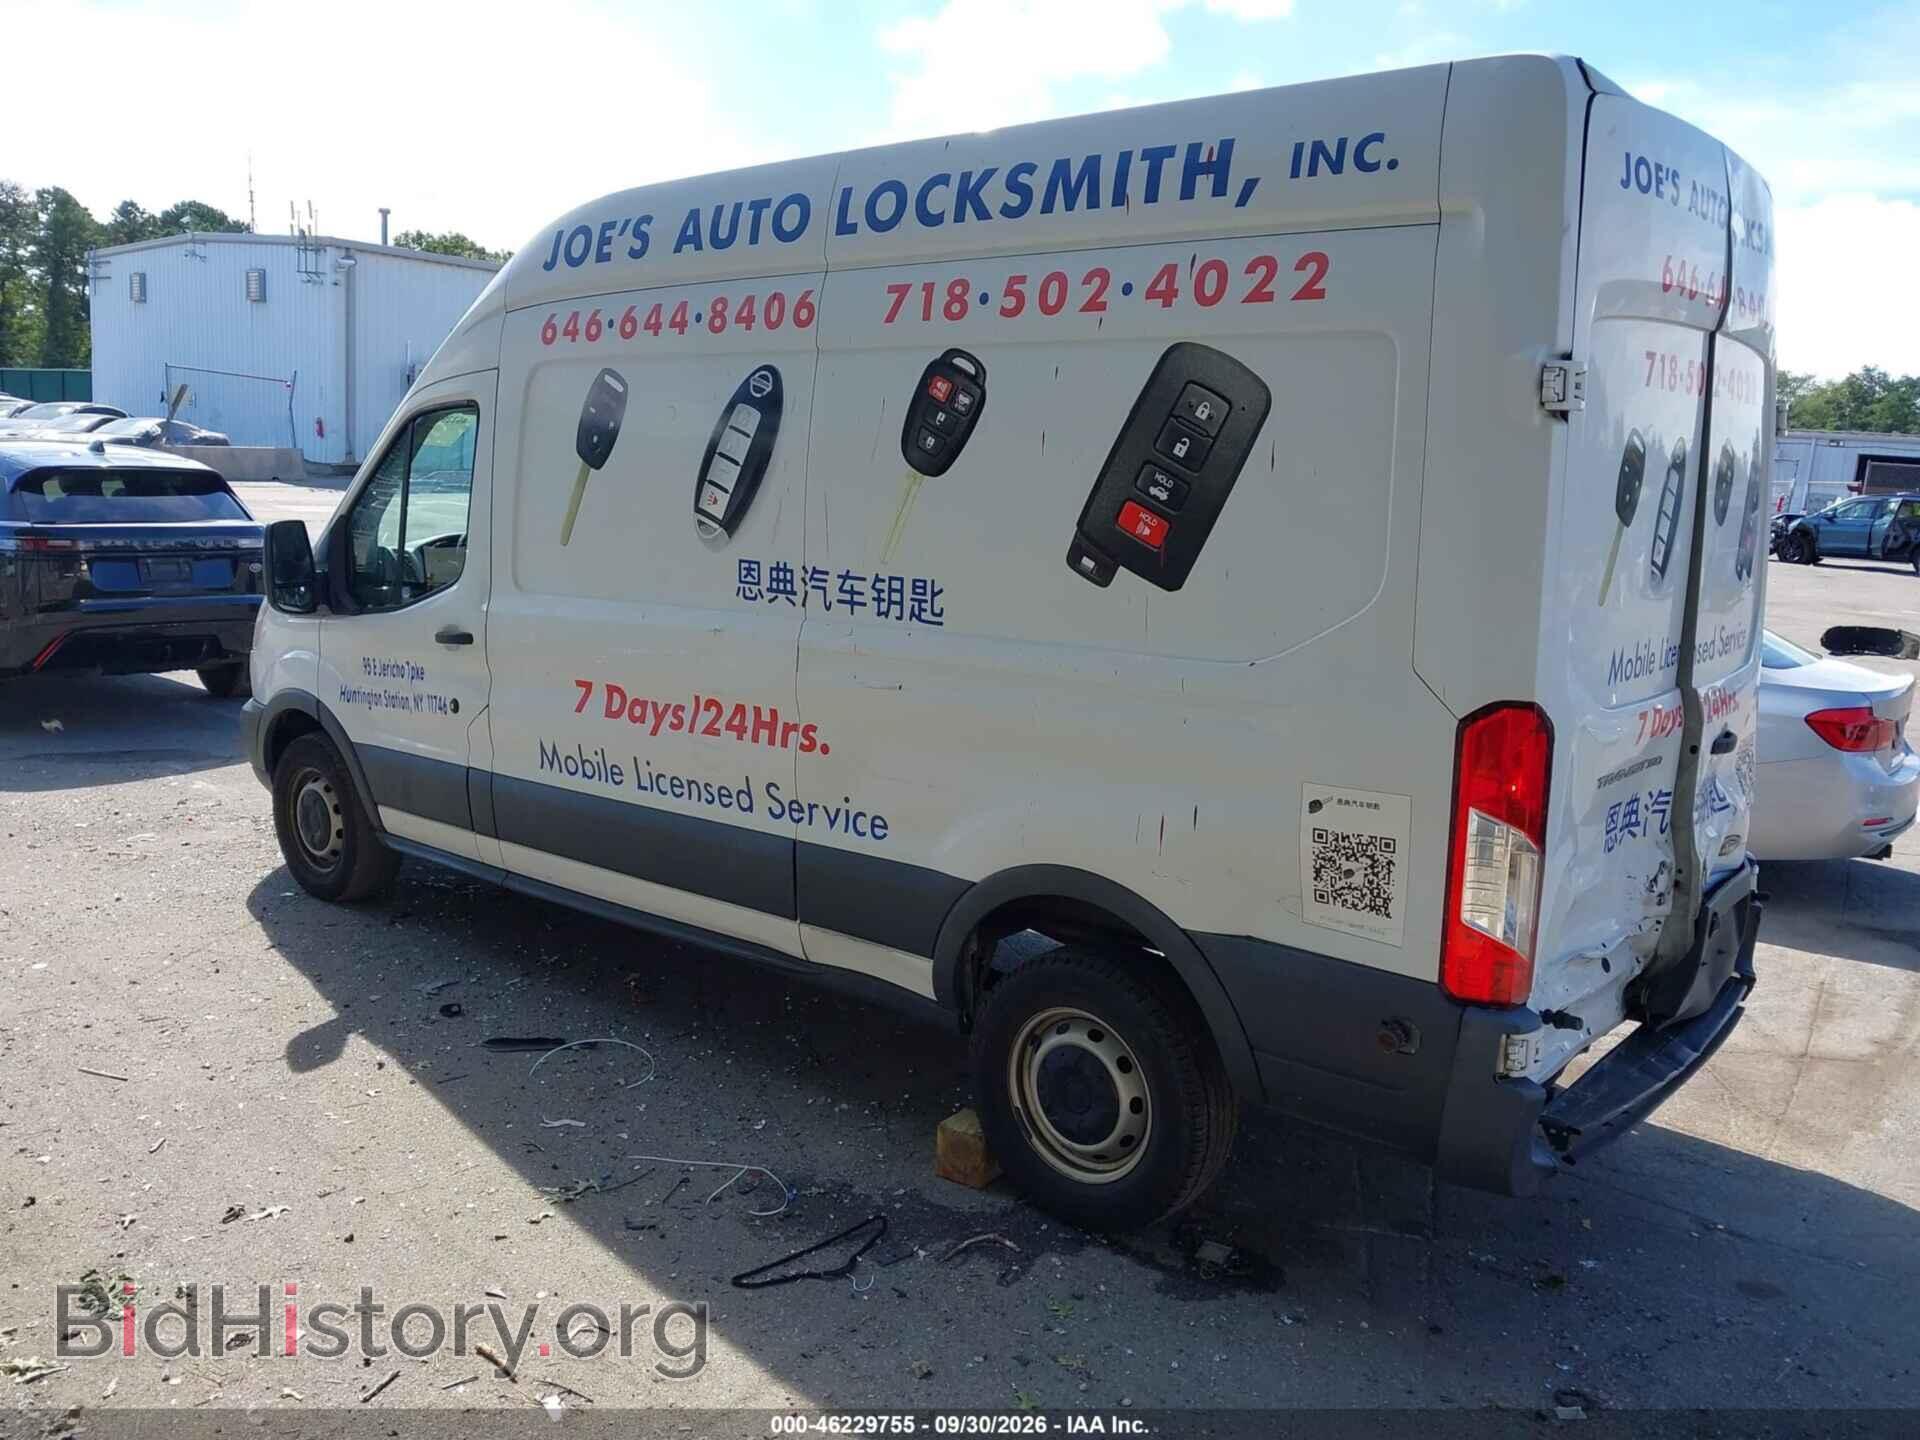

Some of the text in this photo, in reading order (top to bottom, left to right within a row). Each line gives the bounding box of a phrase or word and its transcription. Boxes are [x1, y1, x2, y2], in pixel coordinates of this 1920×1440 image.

[542, 132, 1399, 271] JOE'S AUTO LOCKSMITH, INC.
[1620, 151, 1680, 207] JOE'S
[1154, 472, 1174, 488] HOLD
[736, 558, 944, 626] 恩典汽车钥匙
[378, 658, 405, 680] Jericho
[406, 660, 425, 688] Tpke
[1608, 639, 1655, 687] Mobile
[413, 695, 424, 713] NY
[574, 679, 830, 755] 7 Days/24Hrs.
[1636, 711, 1648, 745] 7
[539, 737, 889, 840] Mobile Licensed Service
